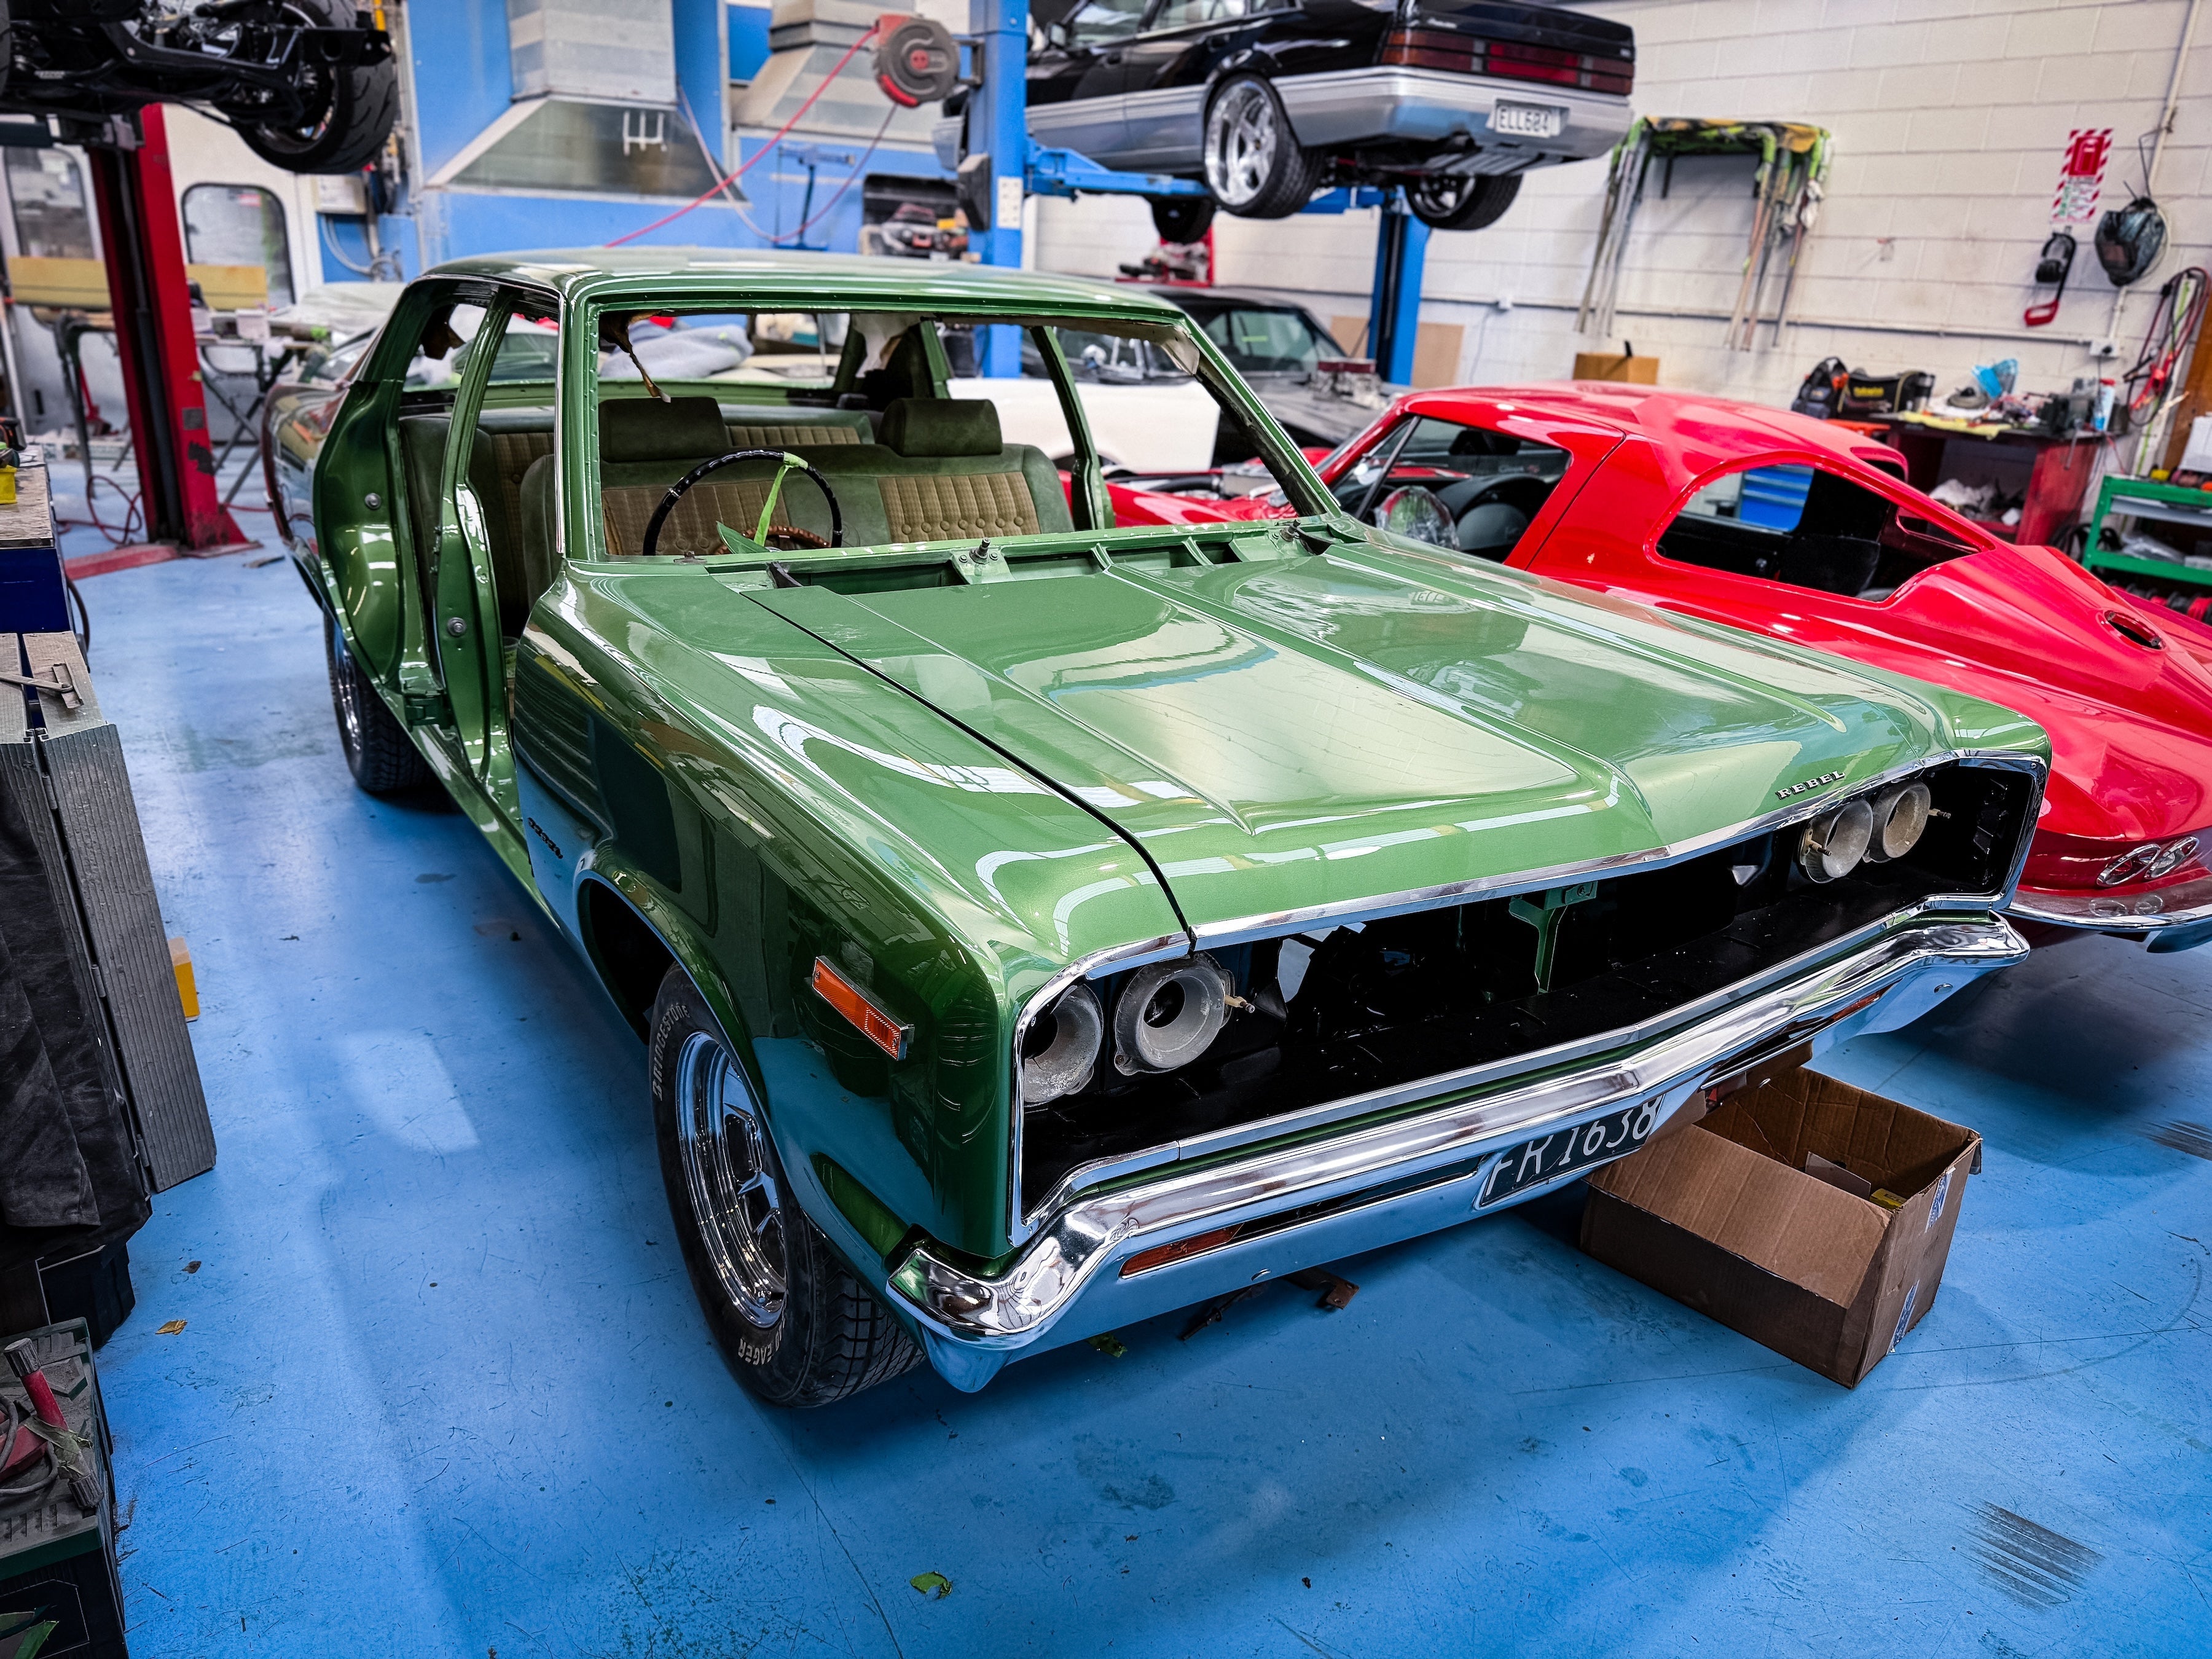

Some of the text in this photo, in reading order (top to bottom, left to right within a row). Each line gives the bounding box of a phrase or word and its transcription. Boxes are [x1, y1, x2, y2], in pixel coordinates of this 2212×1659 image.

[1776, 770, 1845, 799] REBEL
[653, 1002, 690, 1102] BRIDGESTONE
[738, 1338, 772, 1365] EAGER
